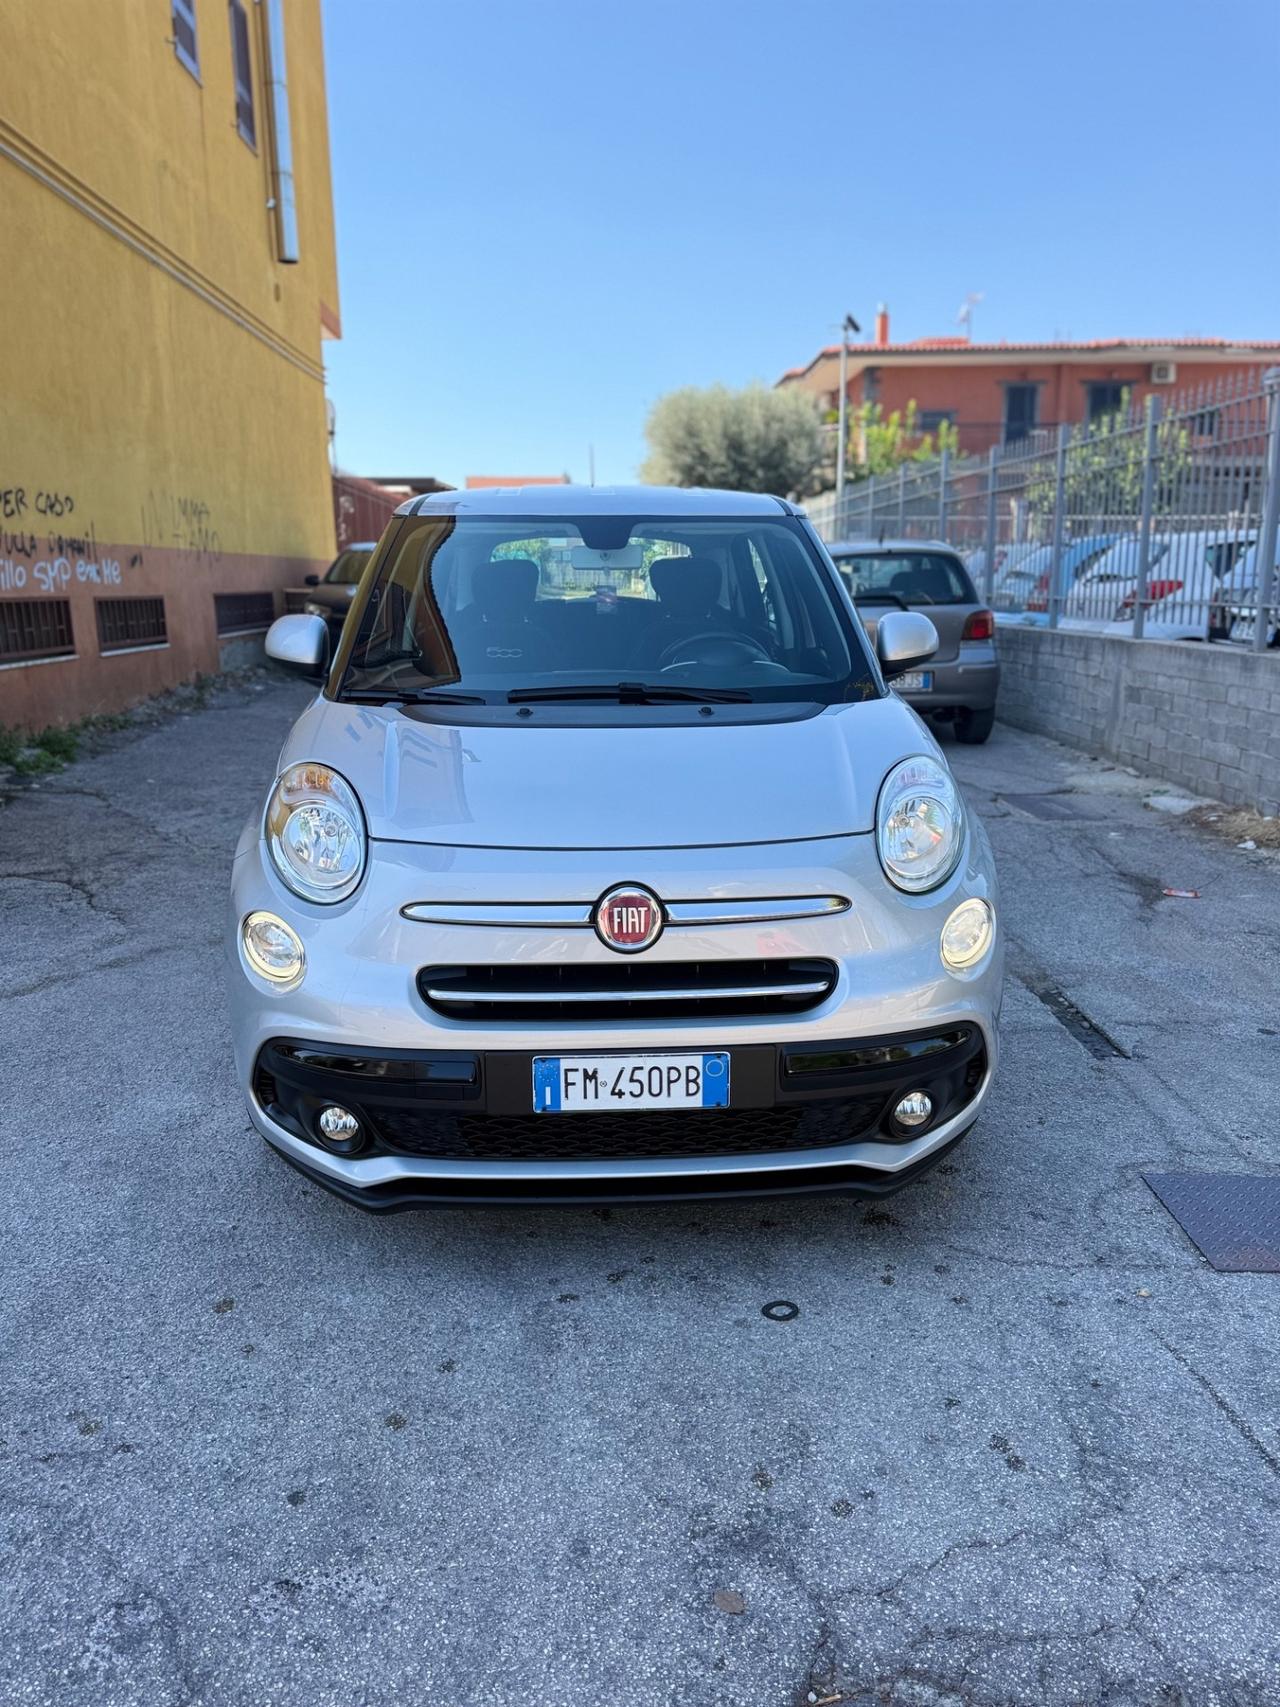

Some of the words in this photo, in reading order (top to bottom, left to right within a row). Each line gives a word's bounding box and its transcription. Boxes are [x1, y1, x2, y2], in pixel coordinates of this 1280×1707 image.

[35, 491, 75, 517] CASO
[613, 906, 648, 934] FIAT
[610, 1064, 701, 1100] 450PB
